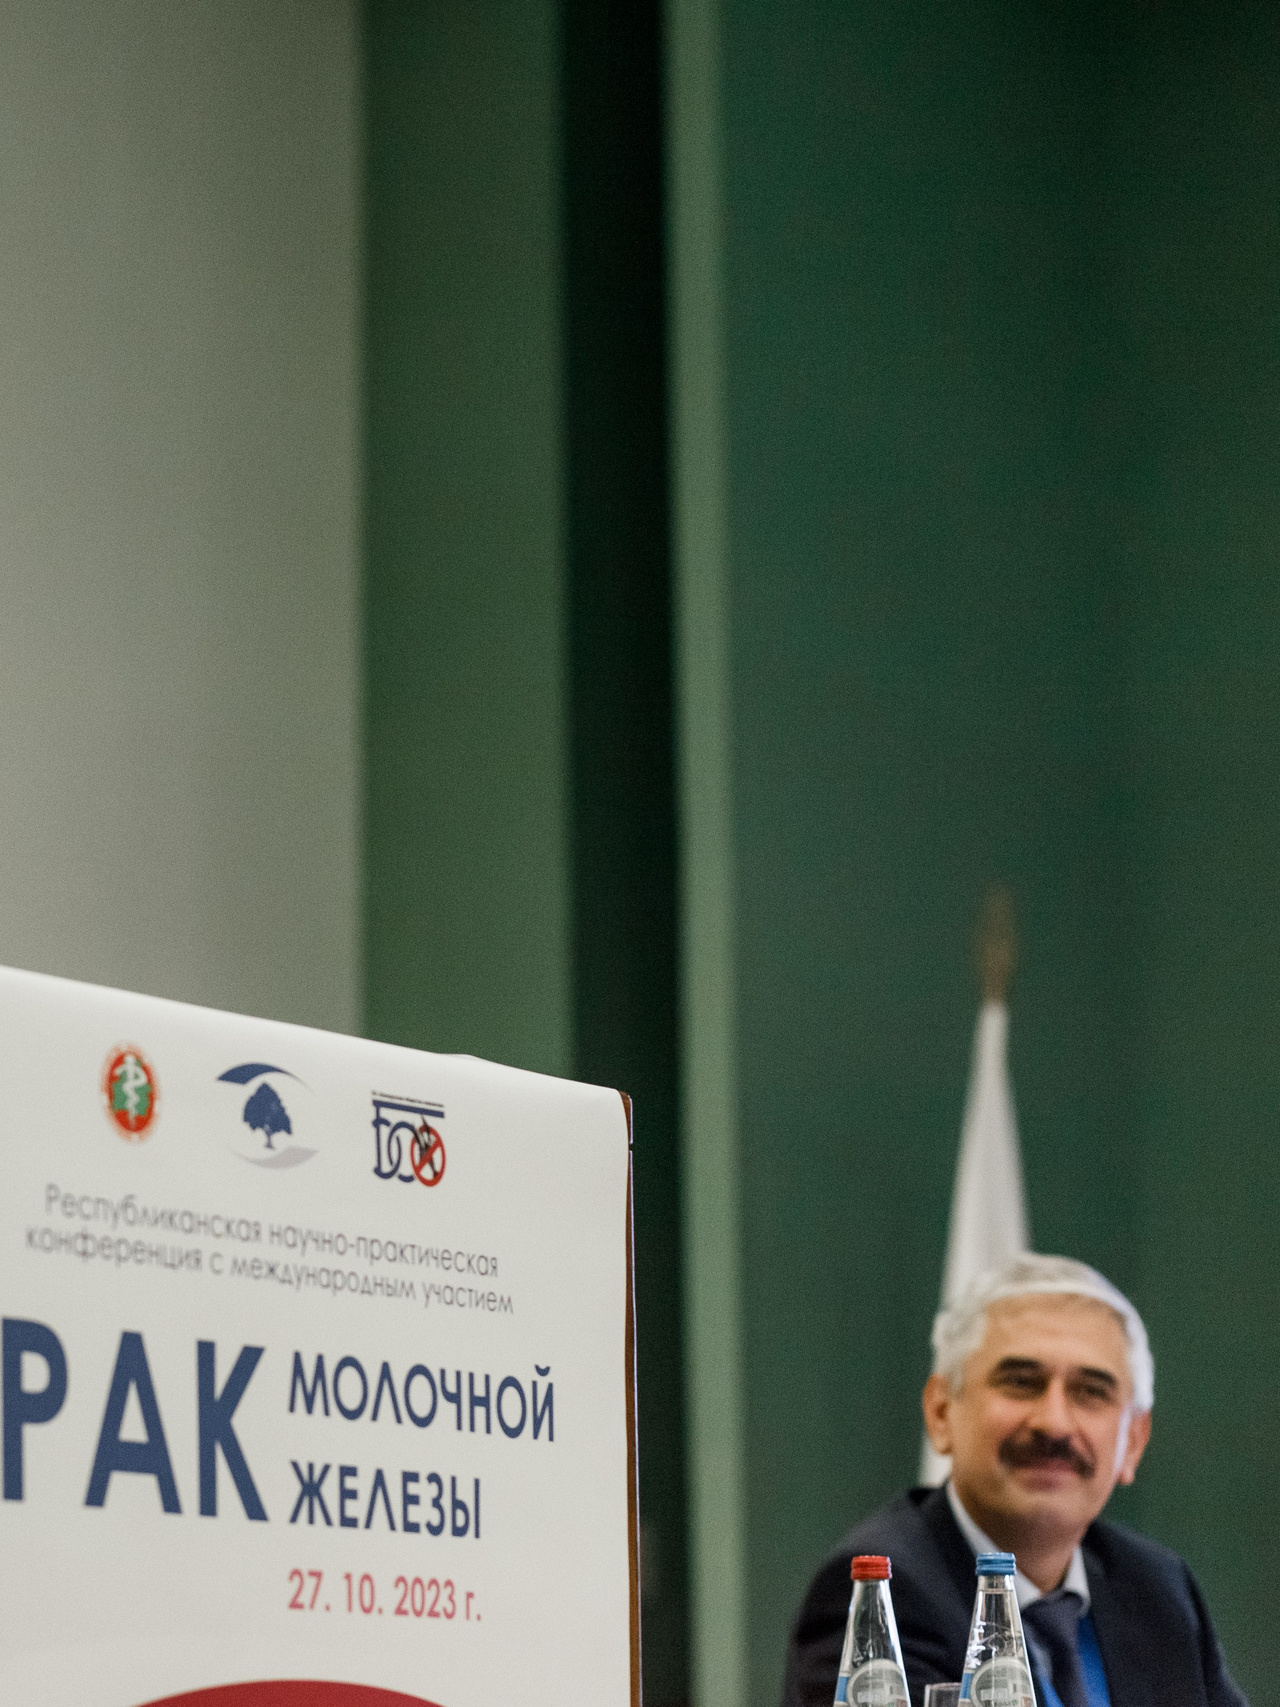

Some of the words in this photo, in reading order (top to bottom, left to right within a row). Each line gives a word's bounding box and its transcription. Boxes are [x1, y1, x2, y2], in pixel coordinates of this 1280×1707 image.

[26, 1228, 202, 1272] конференция
[209, 1252, 223, 1275] с
[230, 1256, 417, 1298] международным
[422, 1281, 514, 1314] участием
[46, 1184, 261, 1243] Республиканская
[269, 1224, 498, 1277] научно-практическая
[0, 1315, 271, 1523] РАК
[287, 1350, 556, 1443] МОЛОЧНОЙ
[288, 1459, 482, 1541] ЖЕЛЕЗЫ
[394, 1575, 458, 1620] 2023
[465, 1590, 482, 1622] г.
